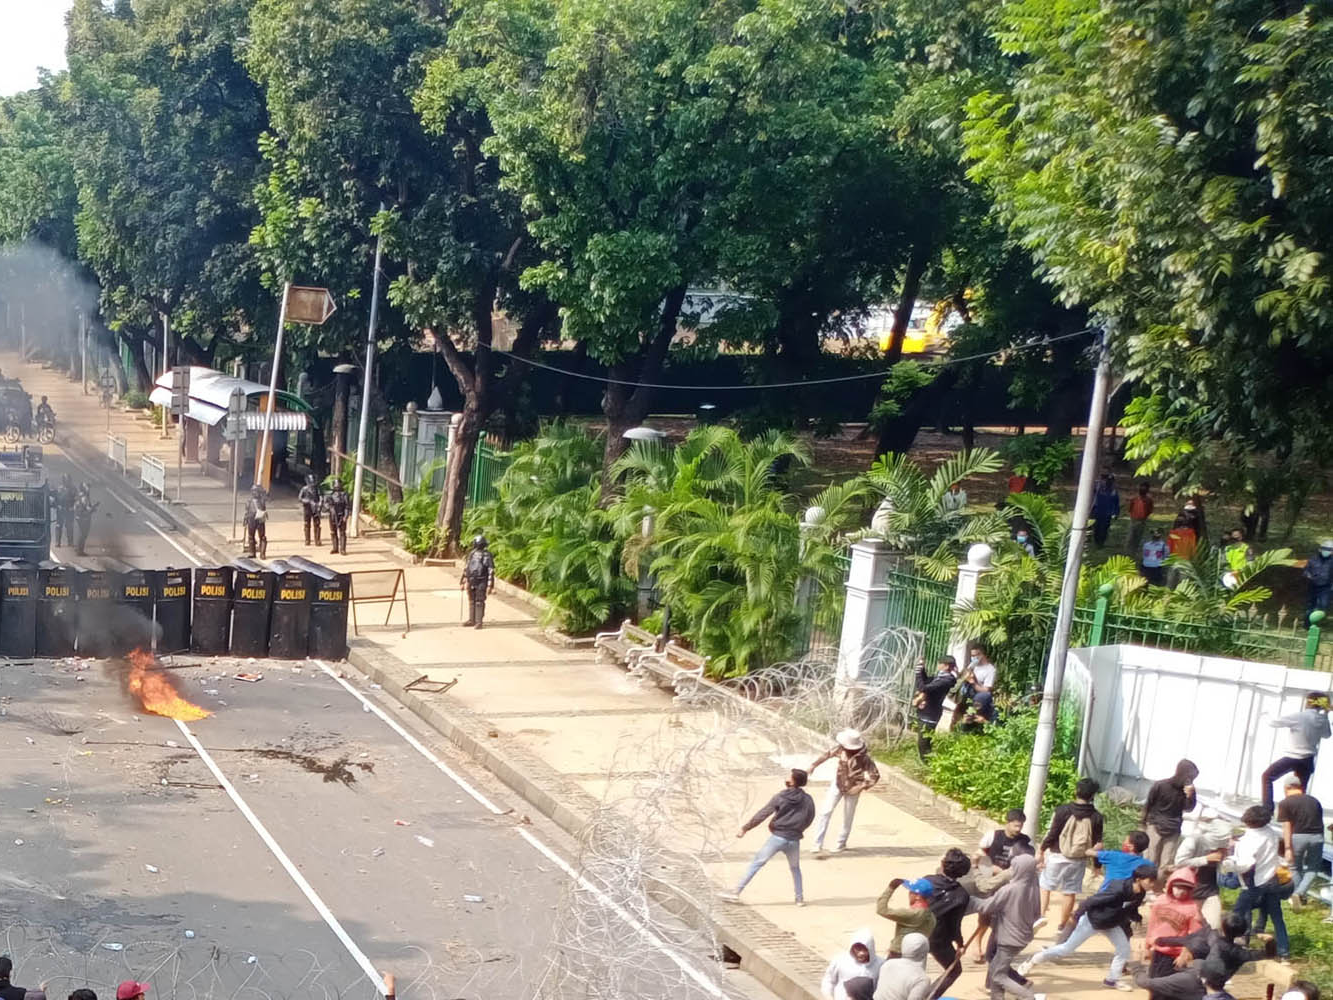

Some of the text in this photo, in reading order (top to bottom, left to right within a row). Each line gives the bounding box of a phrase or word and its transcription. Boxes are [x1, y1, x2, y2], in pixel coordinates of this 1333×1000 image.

[46, 586, 70, 597] POLISI
[125, 586, 150, 597] POLISI
[163, 586, 187, 597] POLISI
[200, 585, 225, 597] POLISI
[241, 588, 267, 600] POLISI
[280, 588, 306, 600] POLISI
[318, 590, 343, 601] POLISI
